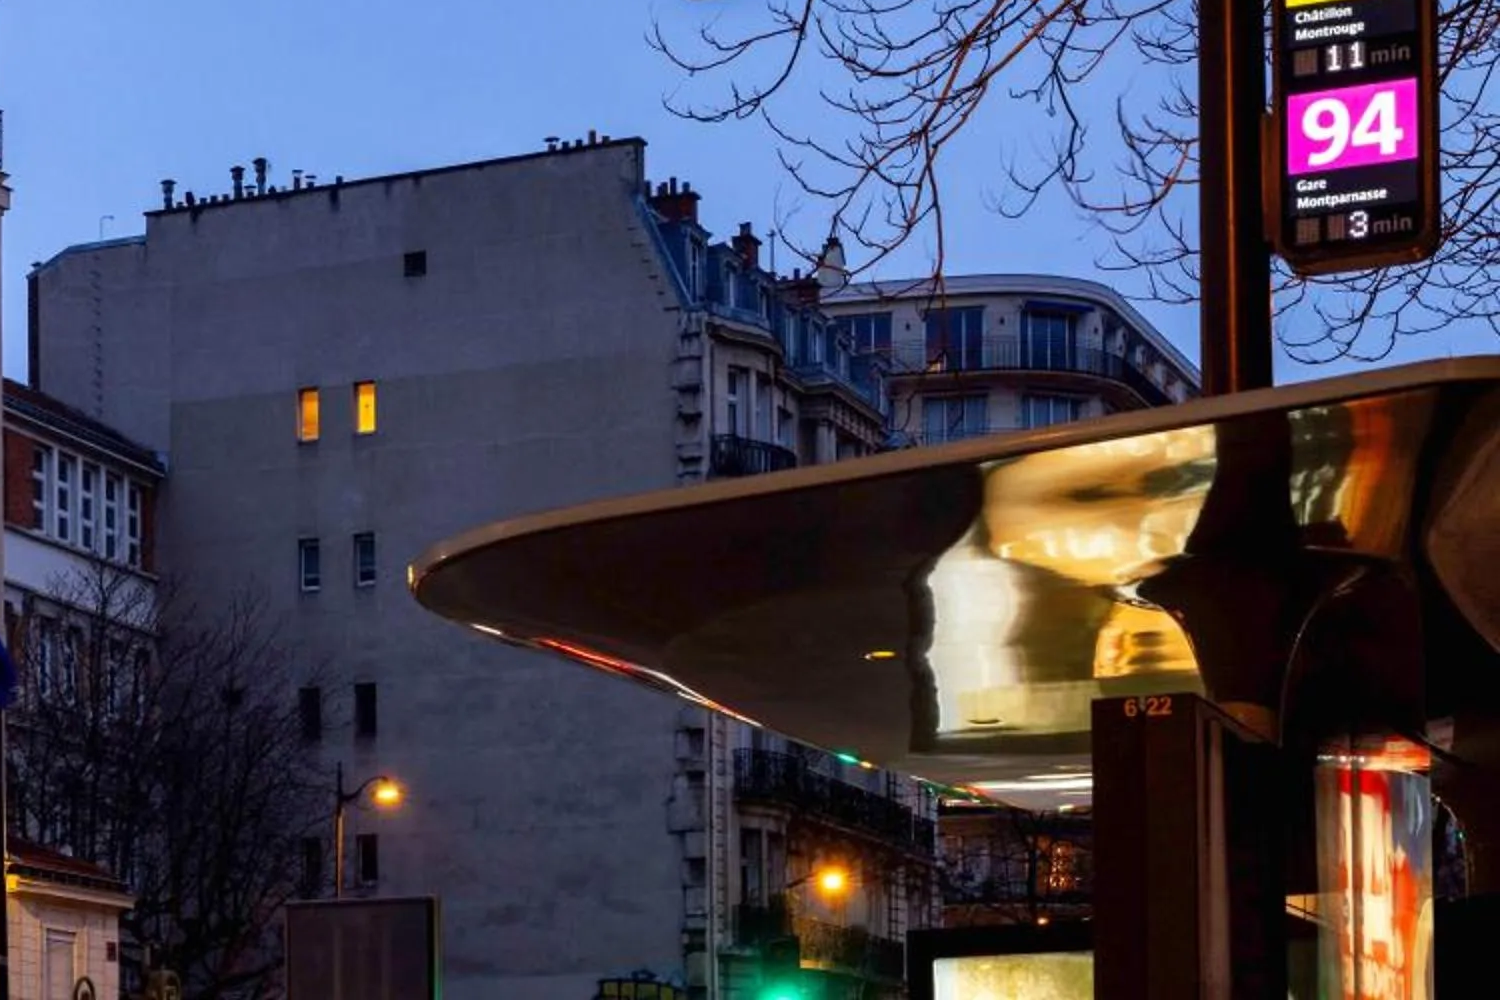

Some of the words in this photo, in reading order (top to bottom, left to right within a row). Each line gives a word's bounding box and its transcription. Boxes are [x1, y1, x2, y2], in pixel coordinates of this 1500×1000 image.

[1294, 5, 1353, 24] Châtillon
[1294, 21, 1365, 41] Montrouge
[1327, 41, 1365, 72] 11
[1370, 44, 1411, 65] min
[1301, 90, 1404, 166] 94
[1296, 179, 1328, 192] Gare
[1296, 188, 1388, 210] Montparnasse
[1349, 210, 1369, 238] 3
[1373, 213, 1412, 235] min
